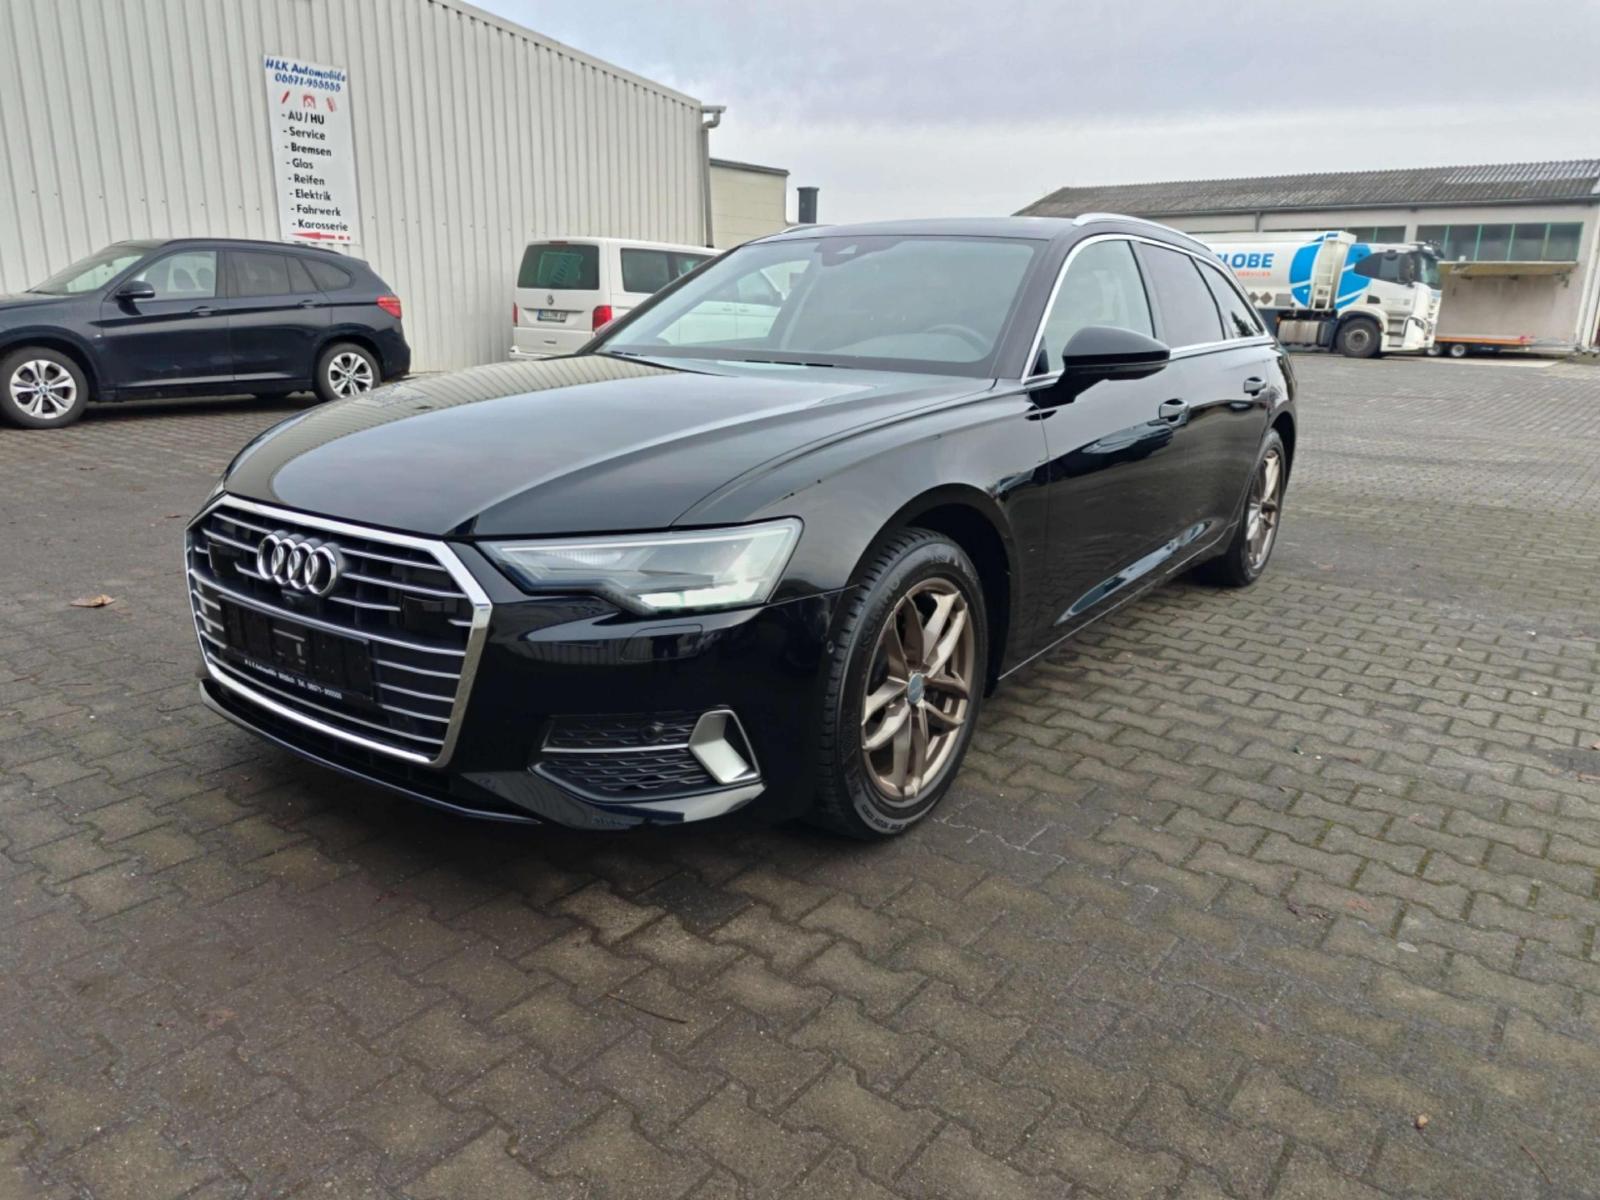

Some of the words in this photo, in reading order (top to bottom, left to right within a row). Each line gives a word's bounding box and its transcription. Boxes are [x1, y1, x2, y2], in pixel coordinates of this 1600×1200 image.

[291, 63, 346, 82] Automobile
[289, 126, 326, 141] Service
[291, 142, 332, 157] Bremsen
[292, 158, 314, 169] Glas
[294, 173, 325, 185] Reifen
[295, 188, 332, 201] Elektrik
[297, 204, 342, 217] Fahrwerk
[298, 219, 349, 232] Karosserie
